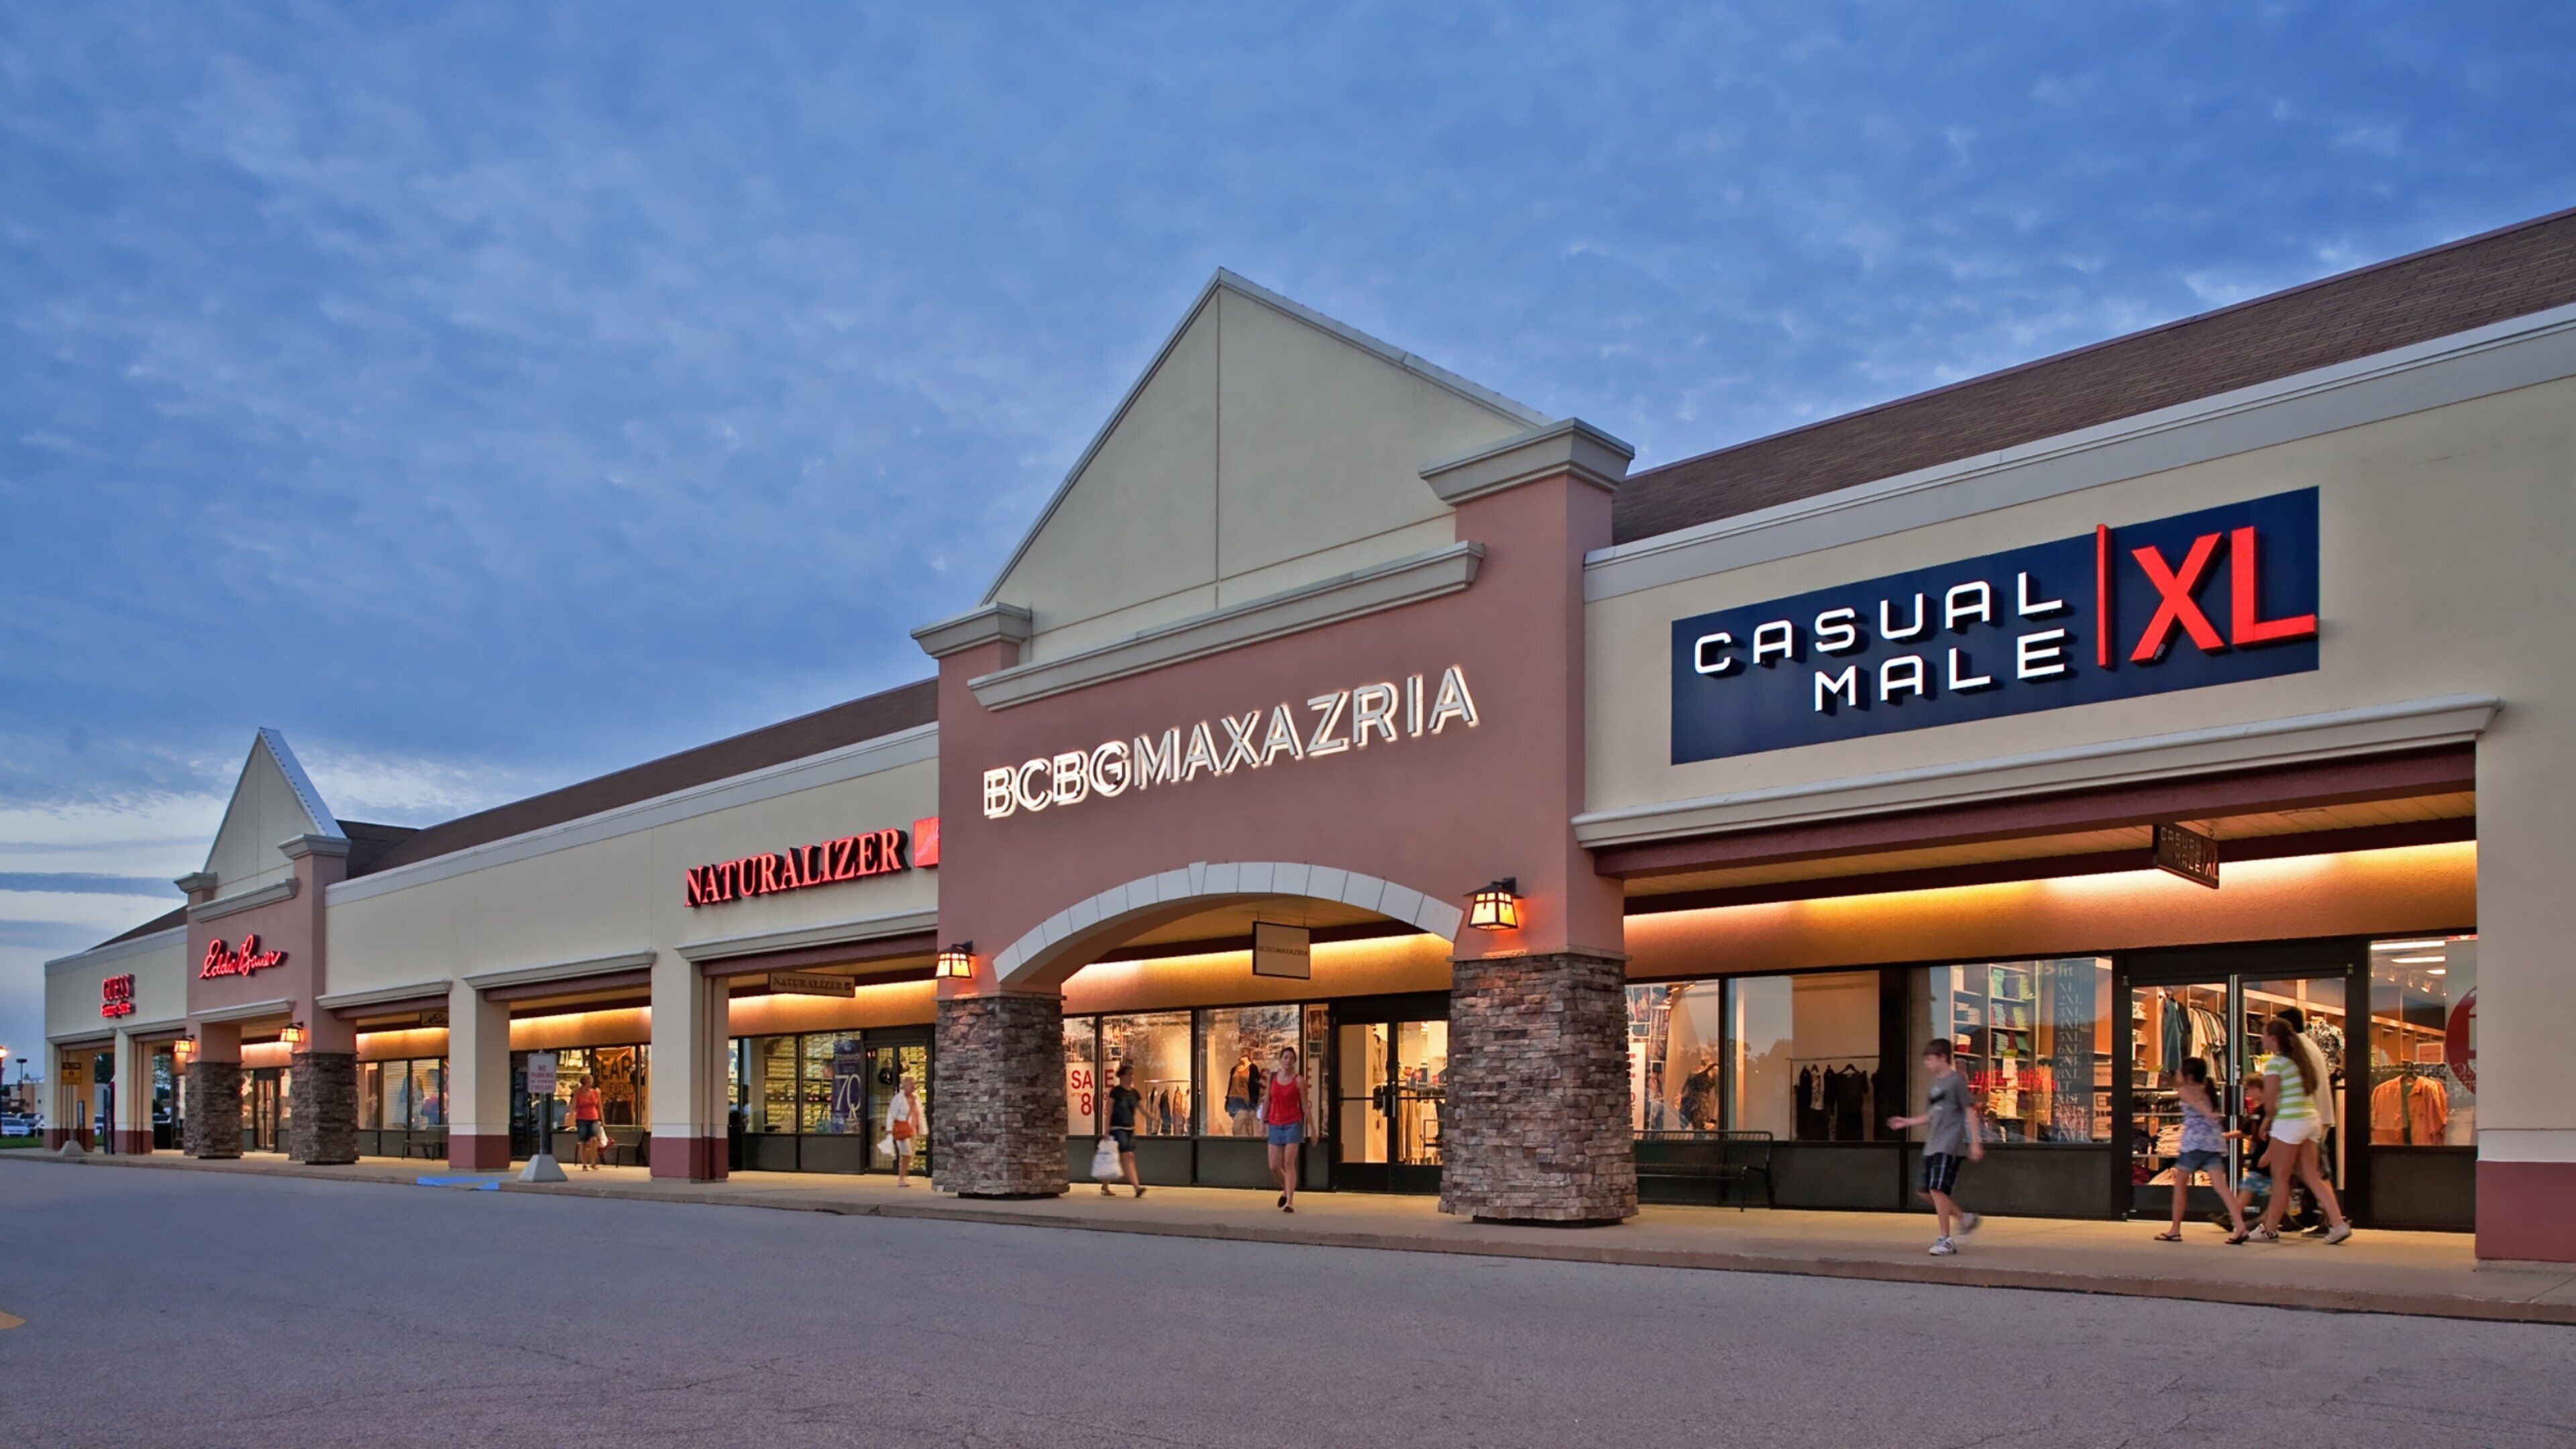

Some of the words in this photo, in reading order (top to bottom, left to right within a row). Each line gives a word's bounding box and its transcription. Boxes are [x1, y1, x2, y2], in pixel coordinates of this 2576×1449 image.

[2129, 526, 2319, 662] XL
[1694, 572, 2063, 676] CASUAL
[1814, 629, 2065, 713] MALE
[983, 664, 1480, 819] BCBGMAXAZRIA
[684, 828, 907, 907] NATURALIZER
[198, 938, 236, 978] Eddie
[237, 933, 281, 976] Bauer
[102, 974, 129, 1001] GUESS
[773, 977, 843, 990] NATURALIZER
[2057, 994, 2083, 1006] 2XL
[2057, 1006, 2083, 1018] 3XL
[2057, 1031, 2082, 1042] 5XL
[2057, 1043, 2082, 1055] 6XL
[834, 1073, 861, 1112] 70
[1071, 1069, 1114, 1089] SAE
